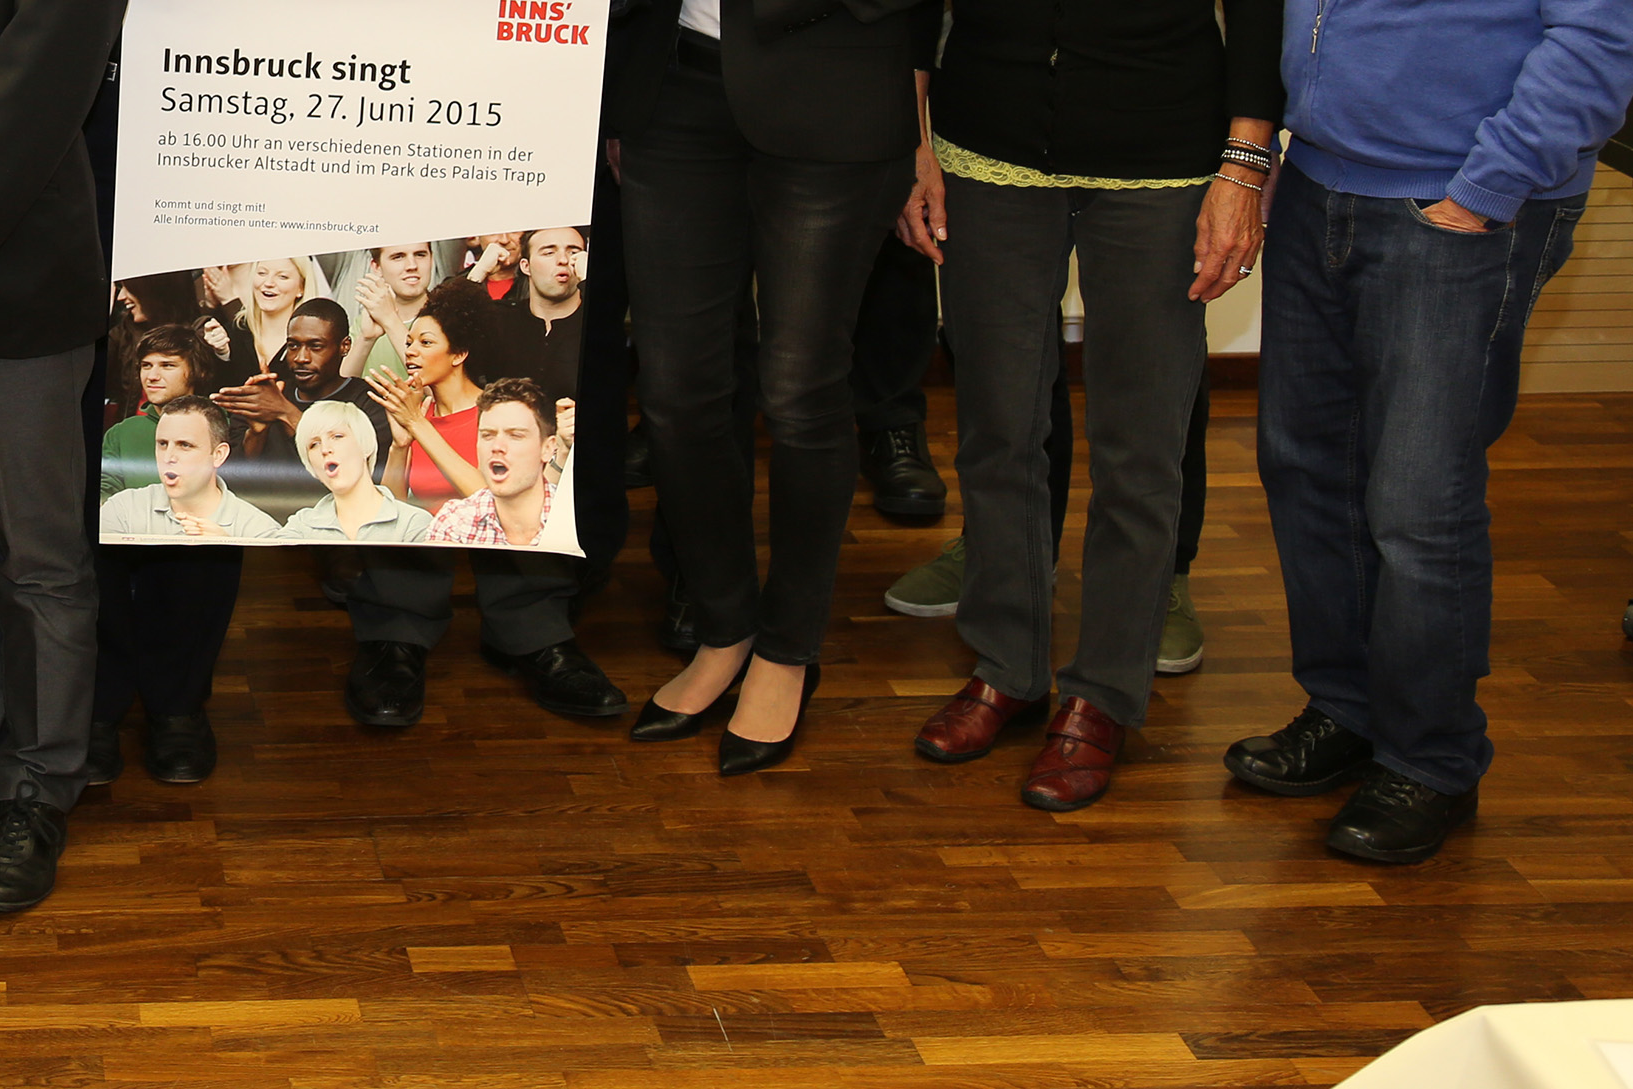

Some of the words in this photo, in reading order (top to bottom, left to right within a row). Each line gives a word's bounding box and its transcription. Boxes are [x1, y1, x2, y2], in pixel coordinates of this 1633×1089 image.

[496, 21, 590, 46] BRUCK
[163, 47, 322, 80] Innsbruck
[331, 53, 412, 92] singt
[160, 86, 295, 125] Samstag,
[306, 93, 347, 120] 27.
[356, 96, 415, 128] Juni
[426, 99, 502, 127] 2015
[158, 130, 177, 146] ab
[182, 132, 227, 148] 16.00
[232, 133, 260, 149] Uhr
[263, 138, 283, 151] an
[287, 137, 402, 156] verschiedenen
[406, 143, 483, 160] Stationen
[487, 145, 502, 161] in
[507, 146, 534, 162] der
[157, 152, 251, 169] Innsbrucker
[253, 155, 316, 173] Altstadt
[321, 159, 351, 175] und
[356, 160, 376, 175] im
[381, 162, 415, 178] Park
[419, 163, 447, 179] des
[452, 164, 498, 181] Palais
[502, 167, 546, 187] Trapp
[154, 198, 192, 210] Kommt
[194, 200, 215, 211] und
[216, 200, 243, 215] singt
[244, 202, 266, 213] mit!
[153, 213, 173, 225] Alle
[174, 214, 246, 227] Informationen
[248, 218, 278, 229] unter:
[279, 220, 379, 235] www.innsbruck.gv.at
